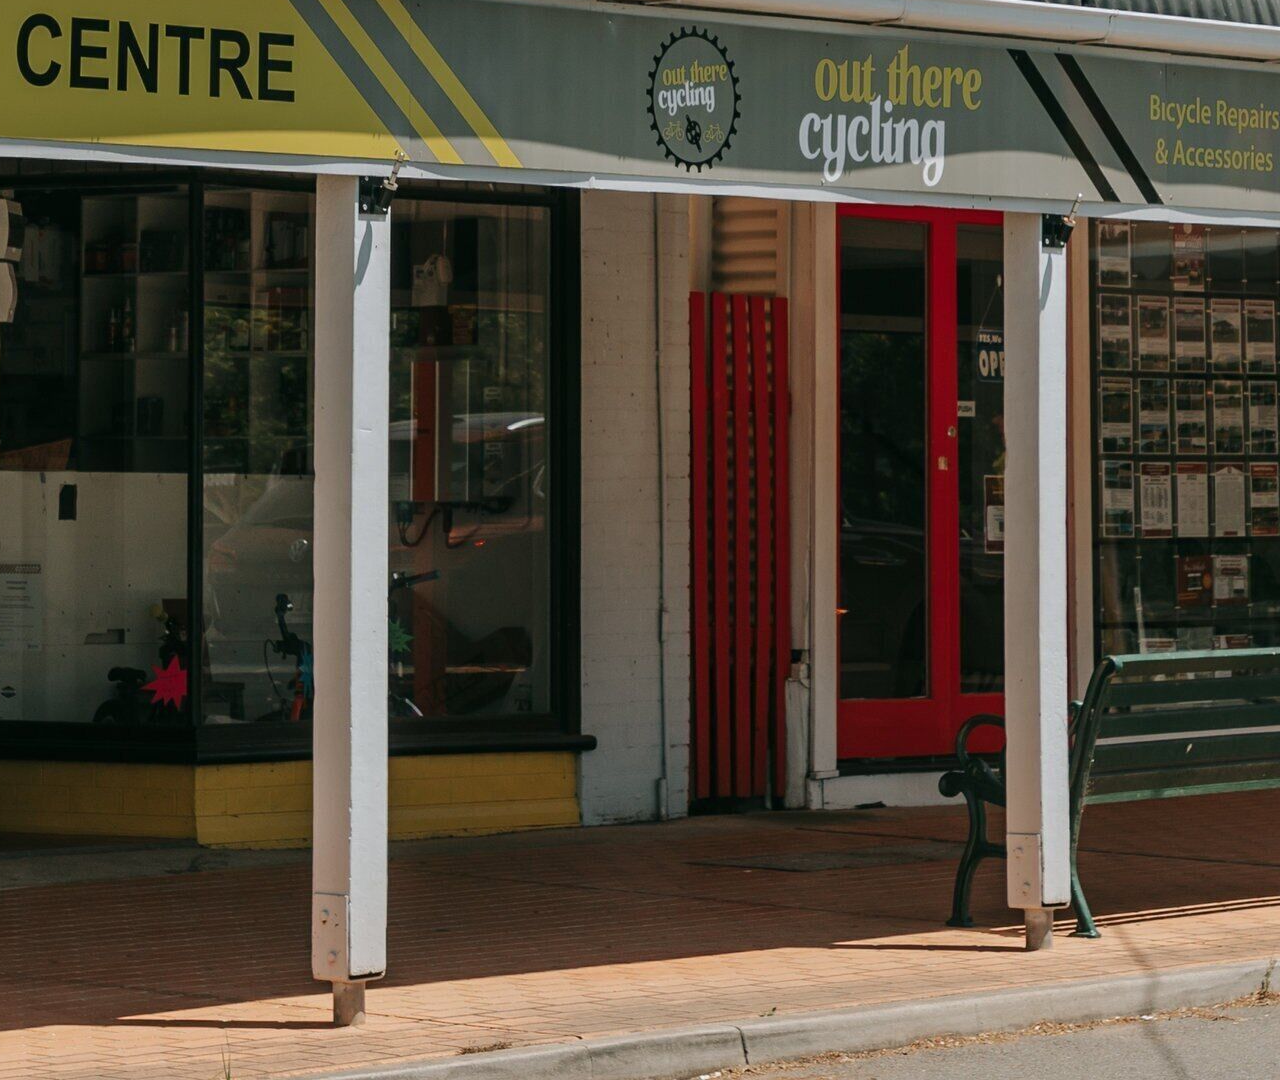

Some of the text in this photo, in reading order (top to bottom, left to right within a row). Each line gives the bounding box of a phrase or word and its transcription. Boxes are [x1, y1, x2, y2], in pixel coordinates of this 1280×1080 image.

[16, 13, 297, 103] CENTRE
[662, 59, 728, 88] out there
[815, 43, 983, 111] out there
[658, 81, 715, 117] cycling
[1149, 94, 1280, 135] Bicycle Repairs
[798, 94, 946, 187] cycling
[1154, 140, 1274, 173] & Accessories
